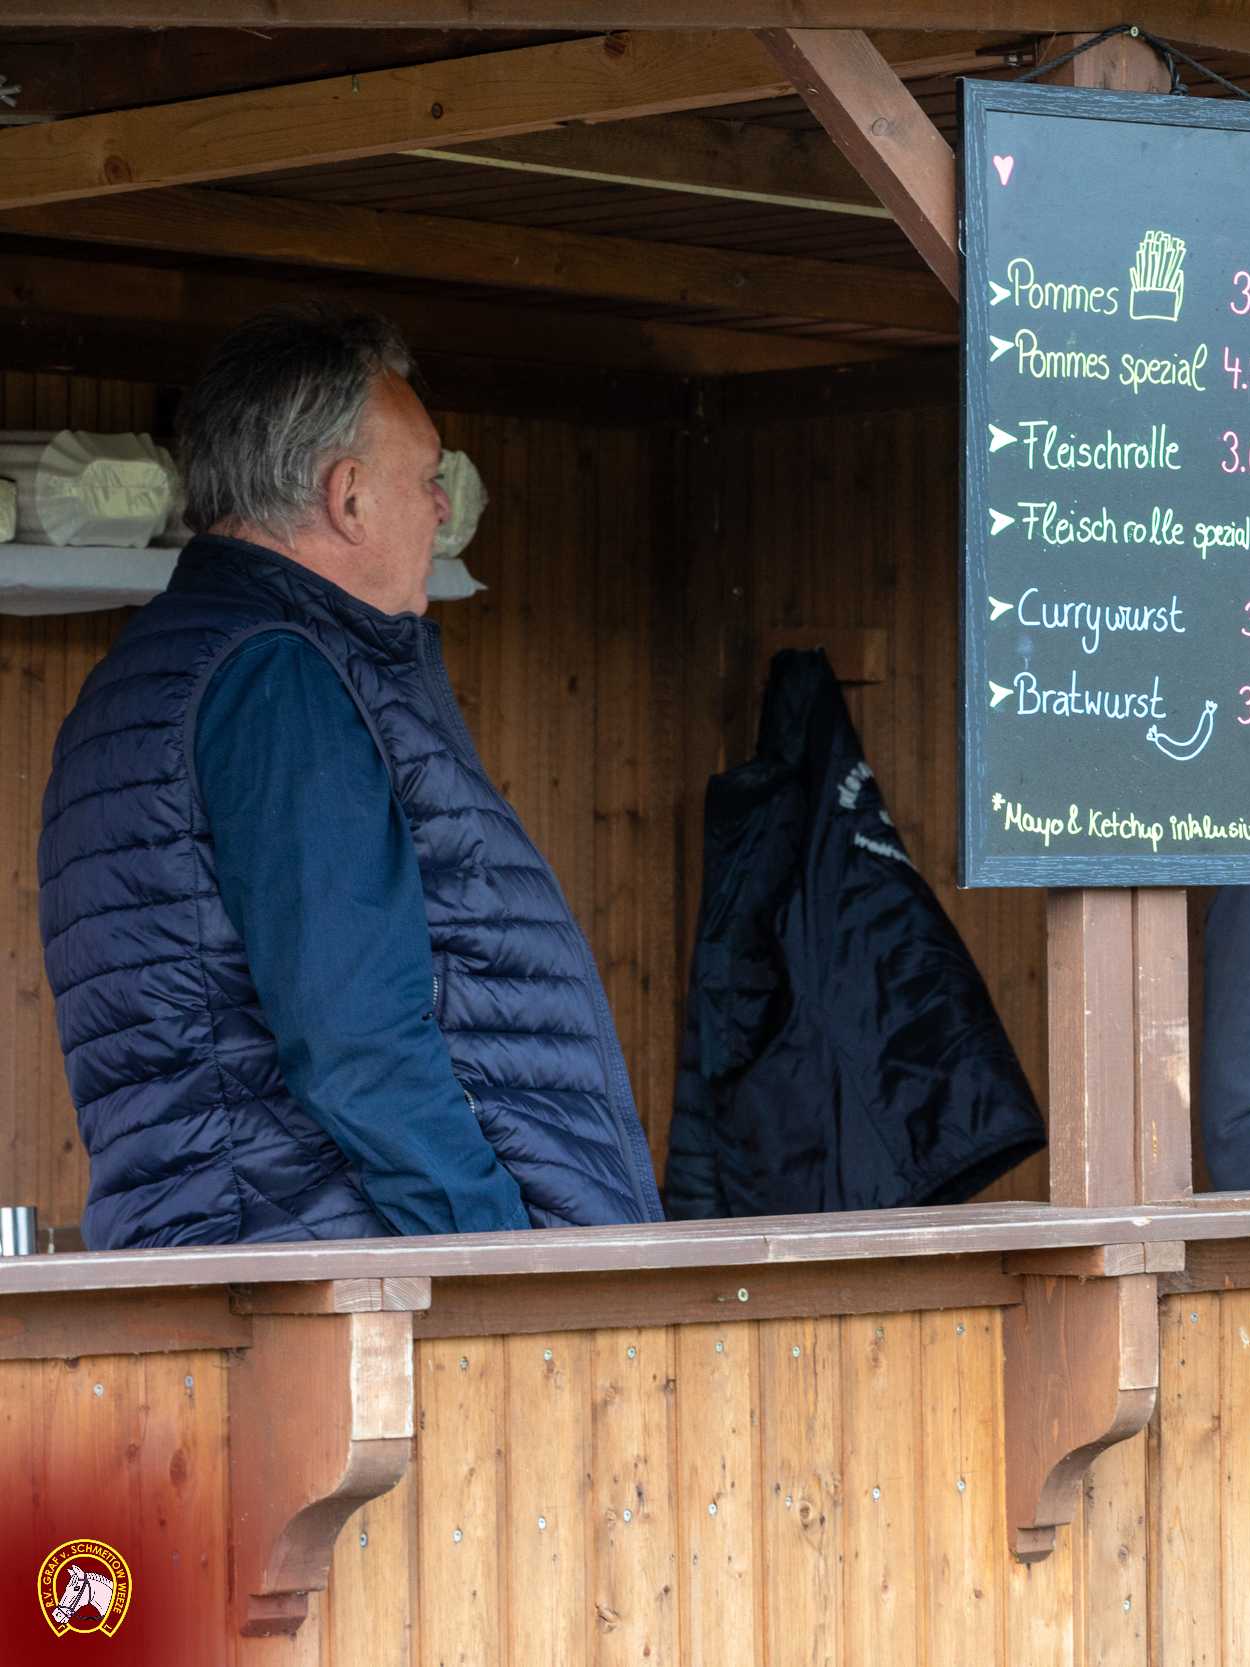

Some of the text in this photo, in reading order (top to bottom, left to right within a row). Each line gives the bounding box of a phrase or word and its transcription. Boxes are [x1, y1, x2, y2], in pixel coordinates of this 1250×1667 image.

[1008, 258, 1119, 315] Pommes
[1015, 329, 1110, 380] Pommes
[1119, 344, 1208, 394] spezial
[1018, 421, 1182, 471] Fleischrolle
[1193, 516, 1250, 560] spezial
[1017, 587, 1186, 654] Currywurst
[1013, 670, 1167, 719] Bratwurst
[1067, 804, 1082, 835] &
[1088, 808, 1164, 852] Ketchup
